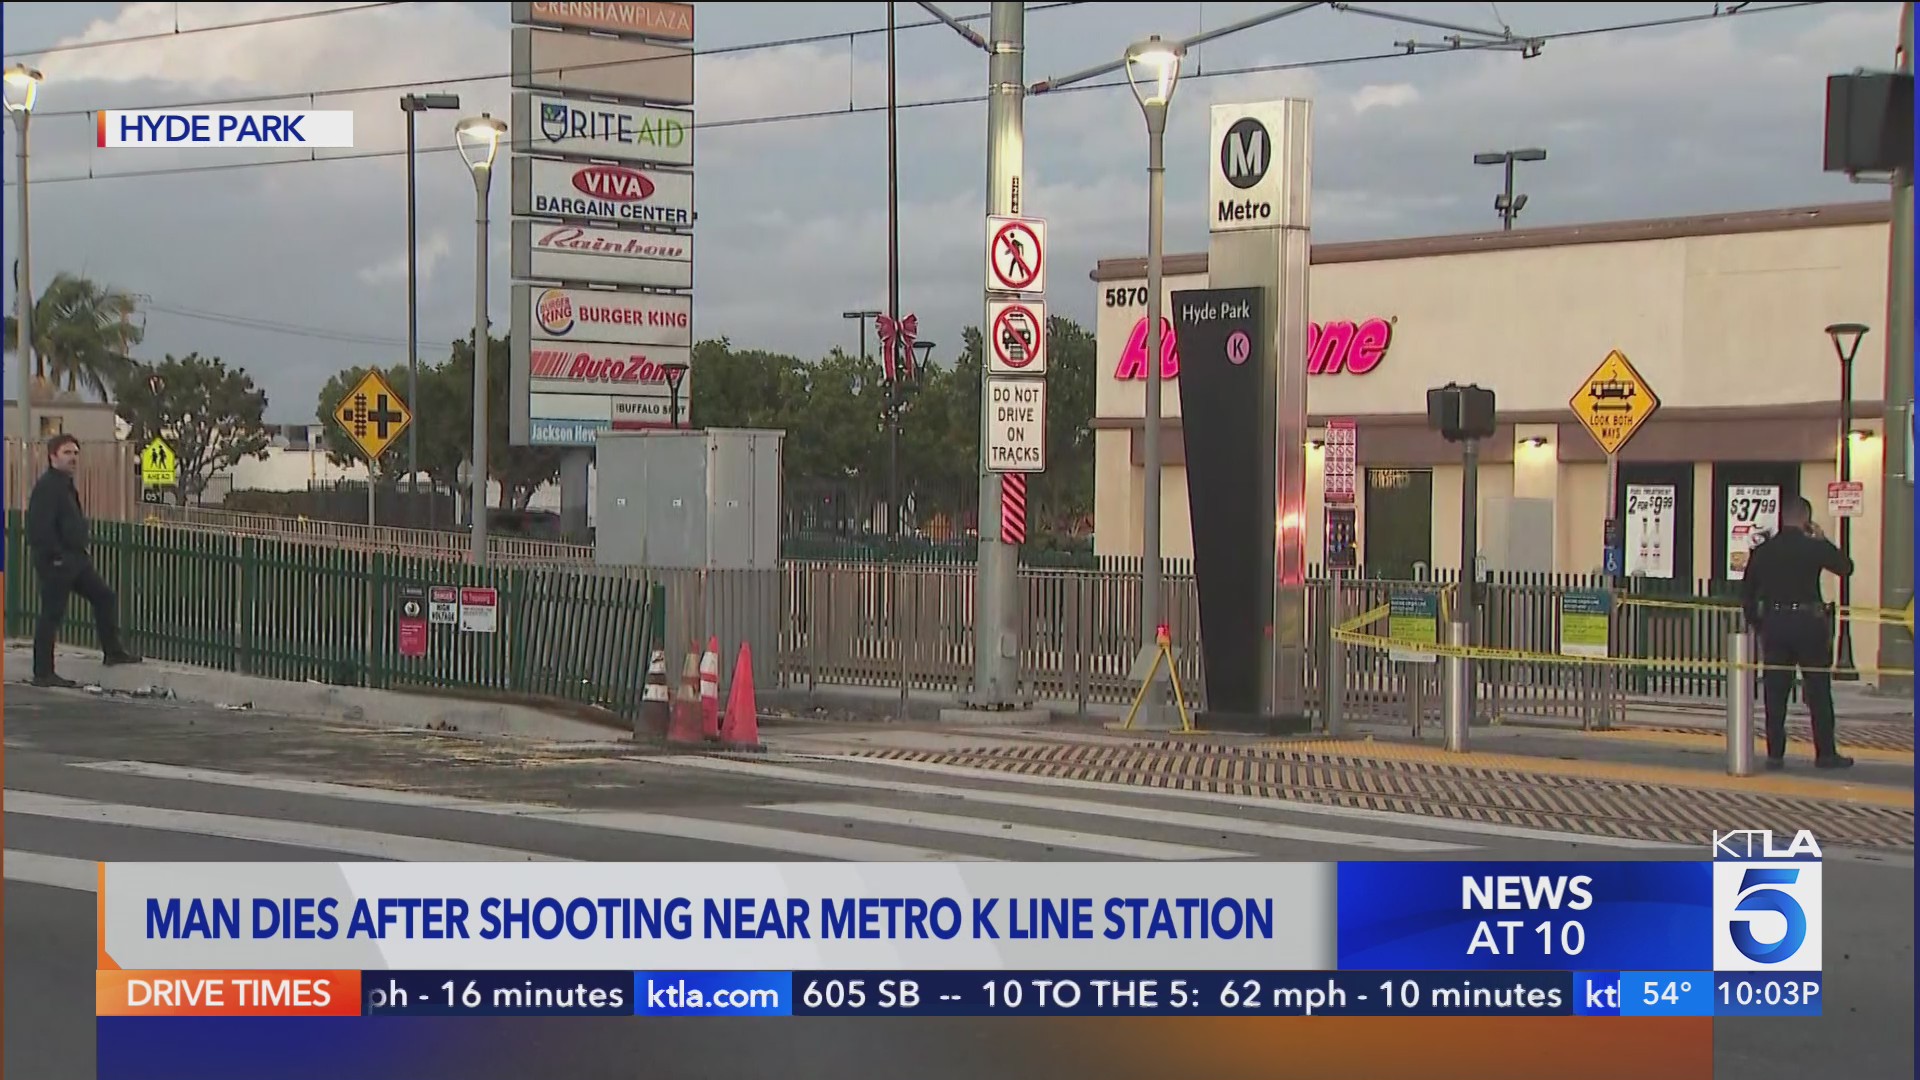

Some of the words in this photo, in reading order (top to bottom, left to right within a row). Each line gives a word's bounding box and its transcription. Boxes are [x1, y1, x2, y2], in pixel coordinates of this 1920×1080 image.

[571, 109, 633, 144] RITE
[637, 117, 684, 149] AID
[584, 171, 644, 198] VIVA
[536, 195, 615, 217] BARGAIN
[620, 204, 688, 223] CENTER
[1218, 200, 1272, 222] Metro
[538, 225, 683, 257] Rainbow
[1105, 287, 1148, 307] 5870
[541, 306, 573, 326] KING
[579, 306, 643, 325] BURGER
[648, 310, 688, 329] KING
[1182, 302, 1217, 326] Hyde
[1220, 299, 1250, 320] Park
[1232, 339, 1245, 358] K
[993, 388, 1011, 403] DO
[1014, 387, 1040, 403] NOT
[618, 403, 660, 415] BUFFALO
[998, 407, 1034, 422] DRIVE
[1590, 415, 1611, 427] LOOK
[1613, 415, 1634, 426] BOTH
[531, 423, 573, 442] Jackson
[1007, 426, 1025, 442] ON
[1601, 427, 1622, 439] WAYS
[992, 446, 1040, 463] TRACKS
[1628, 495, 1638, 515] 2
[1637, 501, 1649, 511] FOR
[431, 611, 455, 622] VOLTAGE
